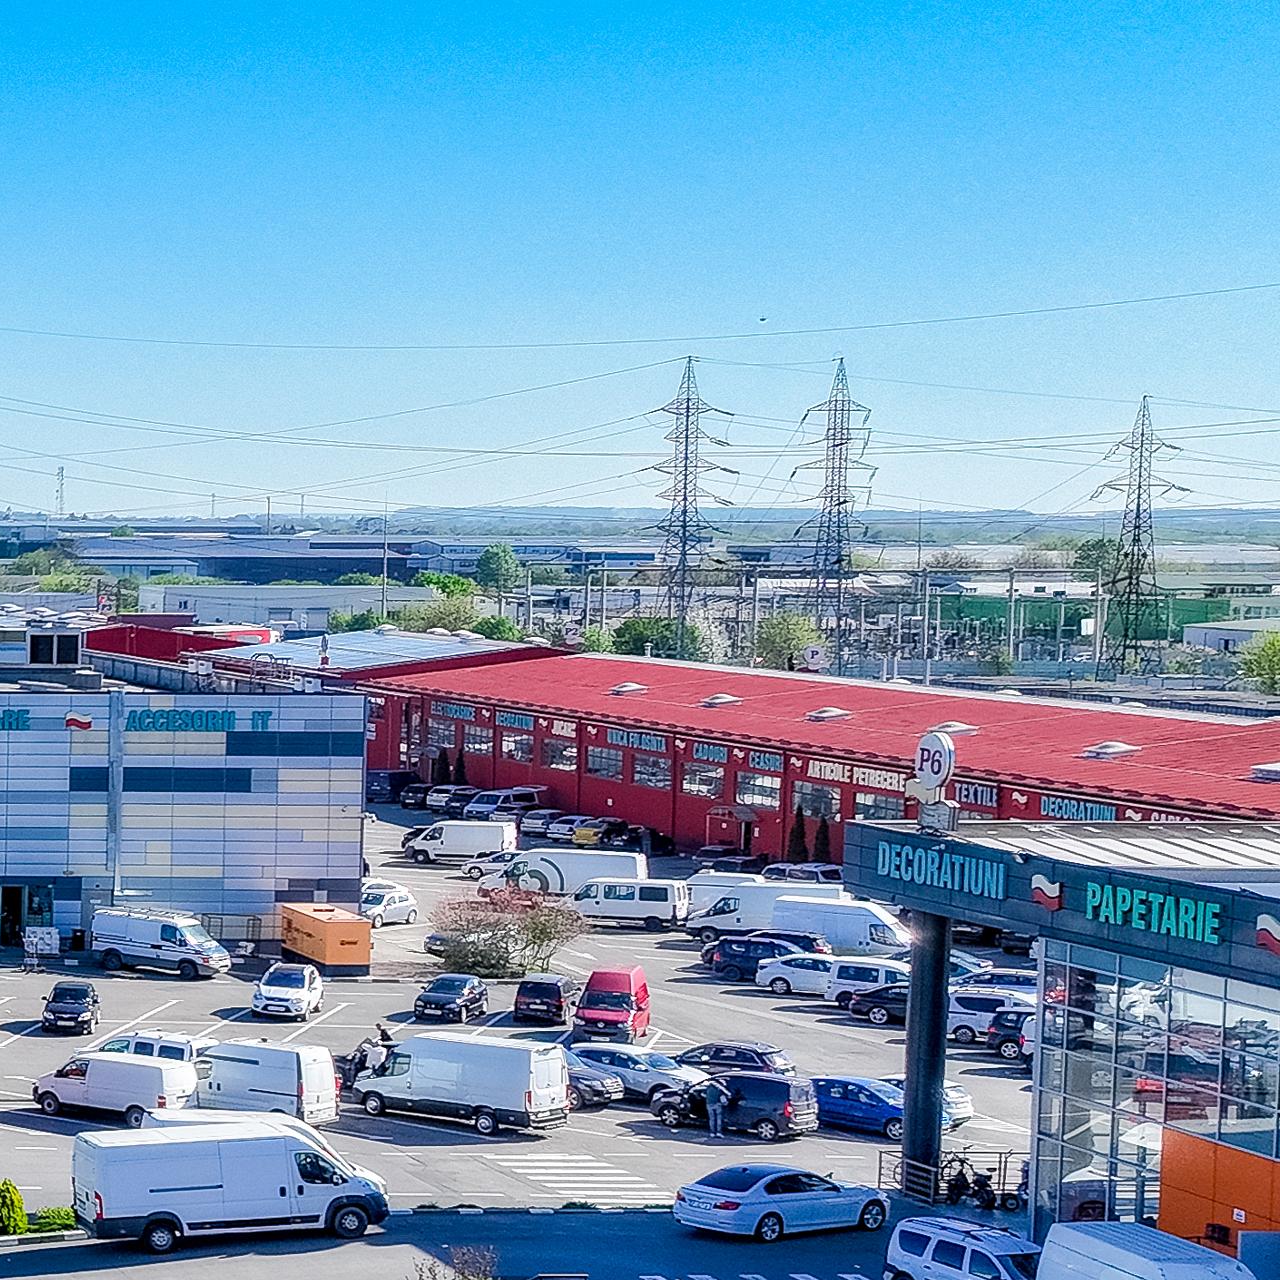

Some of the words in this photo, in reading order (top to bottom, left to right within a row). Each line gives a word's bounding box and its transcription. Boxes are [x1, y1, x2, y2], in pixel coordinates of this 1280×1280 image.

[917, 747, 942, 775] P6
[954, 782, 999, 807] TEXTILE
[1085, 882, 1221, 945] PAPETARIE
